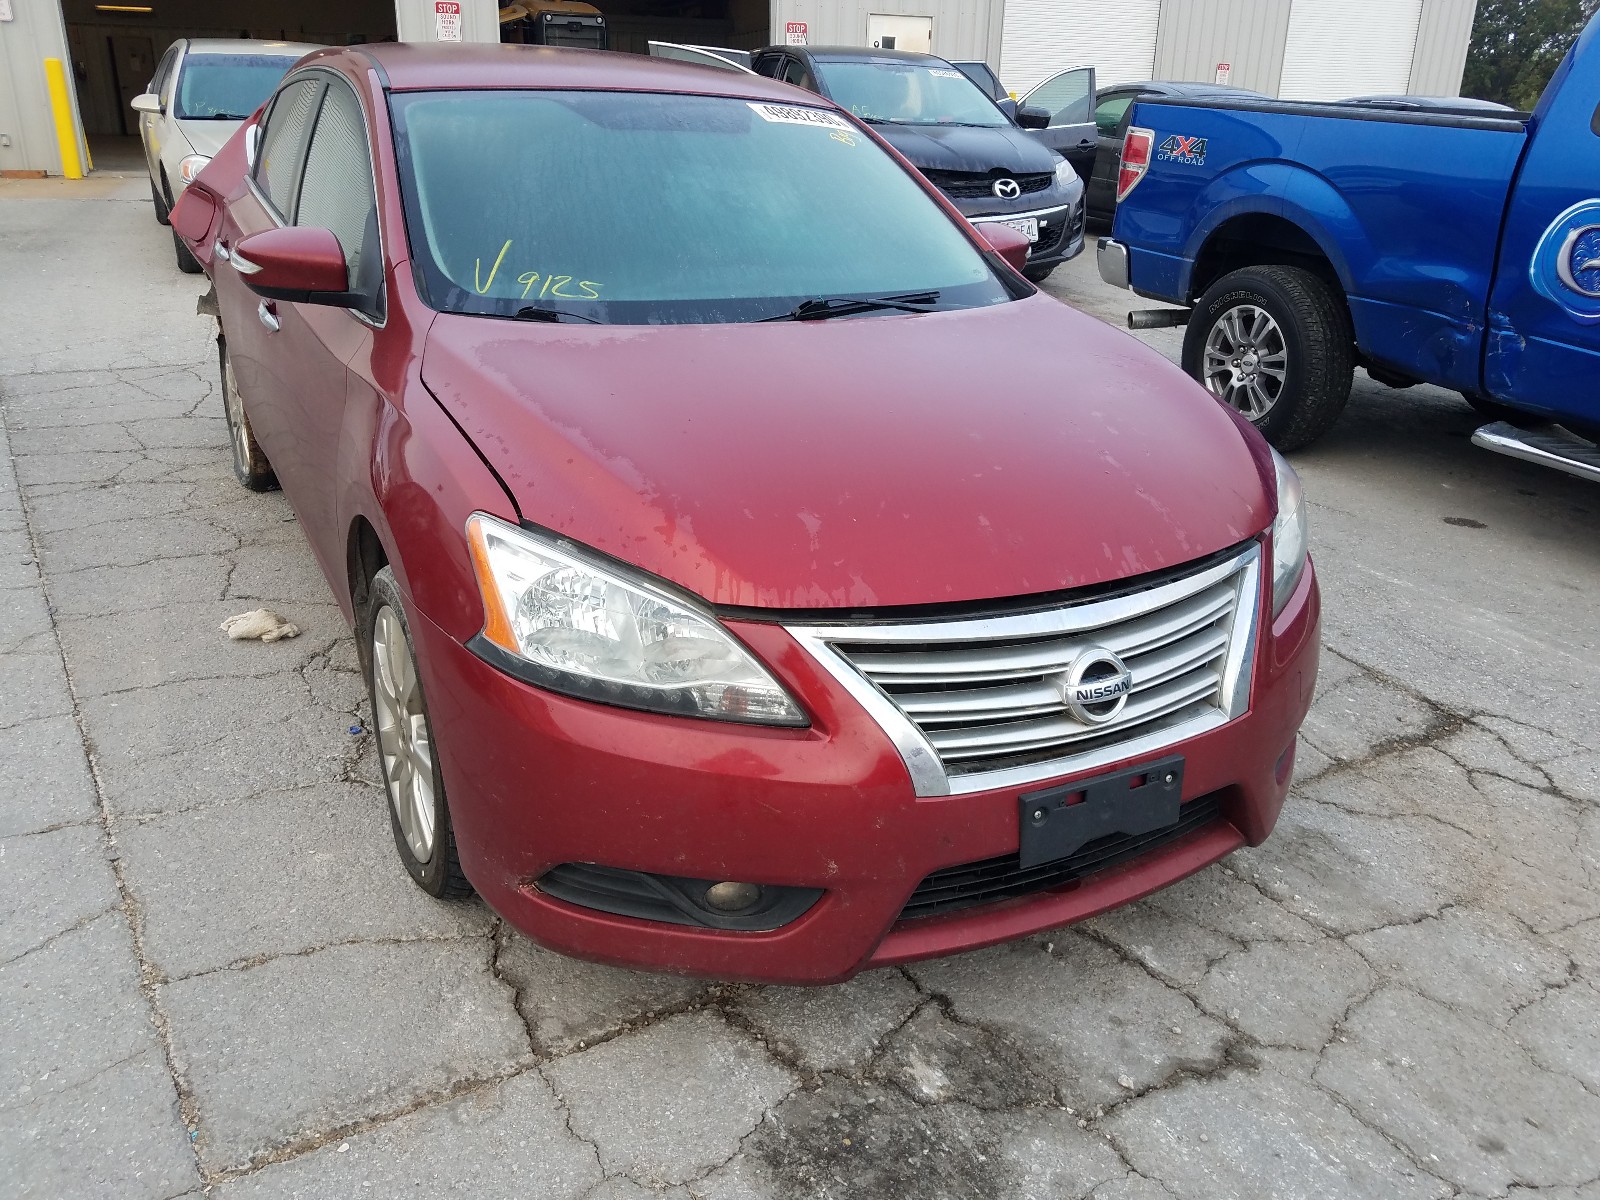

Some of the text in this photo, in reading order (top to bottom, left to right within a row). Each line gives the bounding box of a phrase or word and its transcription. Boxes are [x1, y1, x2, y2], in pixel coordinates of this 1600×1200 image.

[438, 3, 458, 13] STOP
[788, 24, 805, 33] STOP
[1157, 153, 1205, 166] OFF ROAD
[1208, 290, 1268, 314] MICHELIN
[1076, 679, 1130, 701] NISSAN
